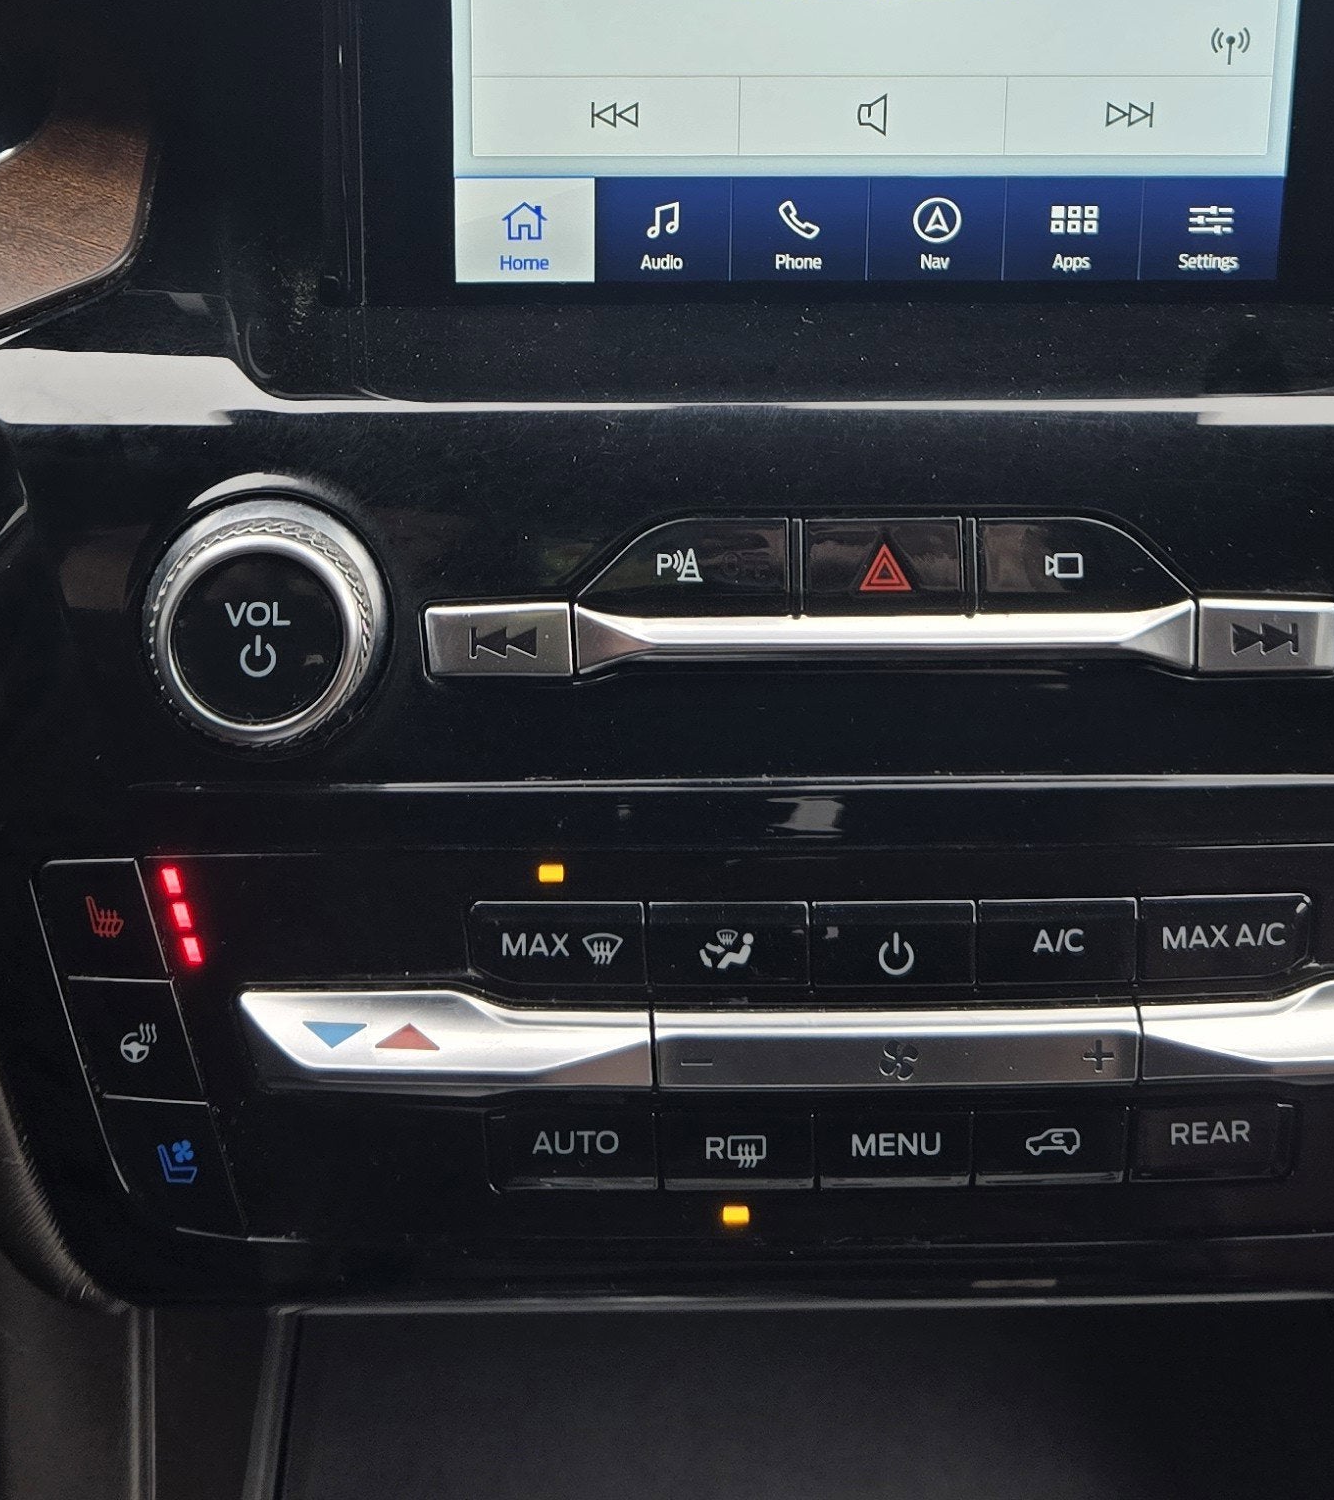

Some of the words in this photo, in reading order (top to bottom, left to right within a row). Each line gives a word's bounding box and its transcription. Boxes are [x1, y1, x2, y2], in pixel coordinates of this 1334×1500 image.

[499, 253, 550, 272] Home
[640, 252, 685, 271] Audio
[775, 252, 824, 271] Phone
[920, 252, 951, 271] Nav
[1051, 252, 1092, 274] Apps
[1177, 252, 1240, 274] Settings
[224, 601, 292, 627] VOL
[501, 932, 570, 958] MAX
[1032, 928, 1085, 954] A/C
[1162, 924, 1230, 950] MAX
[1234, 922, 1287, 948] A/C
[532, 1130, 621, 1156] AUTO
[851, 1131, 942, 1158] MENU
[1170, 1120, 1251, 1146] REAR
[705, 1136, 725, 1161] R
